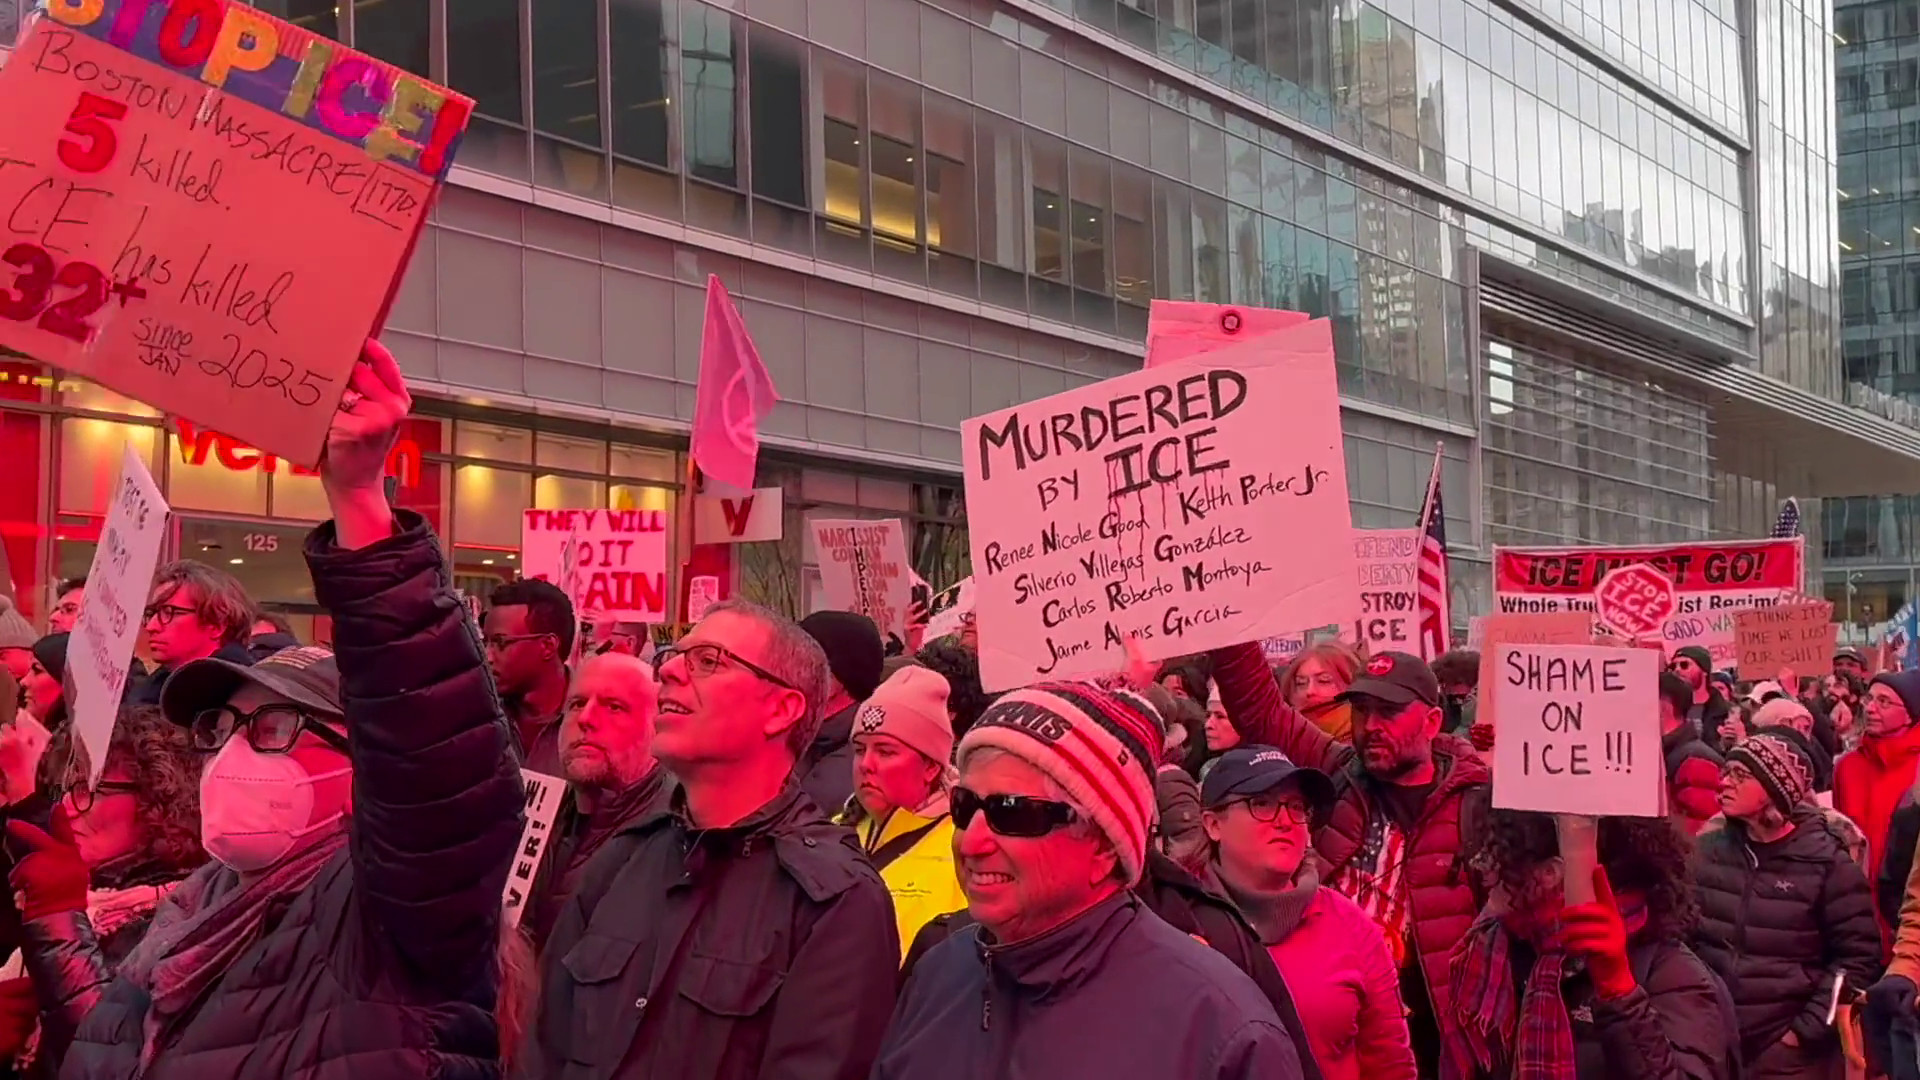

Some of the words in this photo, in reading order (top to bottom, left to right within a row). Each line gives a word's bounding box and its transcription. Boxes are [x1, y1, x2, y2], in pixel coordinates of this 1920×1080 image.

[32, 31, 187, 118] BOSTON
[188, 95, 367, 196] MASSACRE
[282, 39, 468, 174] ICE!
[57, 91, 128, 172] 5
[110, 205, 172, 284] has
[180, 244, 294, 334] killed
[133, 317, 193, 358] since
[199, 334, 334, 406] 2025
[138, 345, 181, 377] JAN
[979, 369, 1247, 481] MURDERED
[1038, 469, 1078, 511] BY
[1104, 426, 1230, 499] ICE
[1178, 484, 1233, 525] Keith
[1239, 473, 1296, 506] Porter
[1295, 464, 1329, 496] Jr.
[243, 533, 278, 551] 125
[525, 510, 597, 531] THEY
[605, 509, 665, 533] WILL
[984, 540, 1034, 576] Renee
[1041, 520, 1094, 555] Nicole
[1098, 506, 1151, 540] Good
[599, 540, 634, 567] IT
[1528, 557, 1583, 587] ICE
[1592, 555, 1692, 586] MST
[1704, 551, 1767, 584] GO!
[1014, 570, 1077, 605] Silverio
[1079, 549, 1145, 584] Villegas
[1042, 596, 1096, 628] Carlos
[1104, 577, 1173, 613] Roberto
[1181, 557, 1273, 592] Montoya
[1621, 571, 1669, 604] STOP
[1500, 595, 1558, 613] Whole
[1566, 597, 1600, 613] Tru
[1737, 613, 1750, 627] I
[1757, 610, 1793, 624] THINK
[1036, 637, 1092, 674] Jaime
[1103, 621, 1154, 651] Alnis
[1161, 603, 1242, 637] Garcia
[1355, 619, 1407, 641] ICE
[1662, 618, 1704, 641] GOOD
[1741, 631, 1769, 645] TIME
[1779, 629, 1793, 643] WE
[1801, 625, 1828, 640] LOST
[1507, 650, 1627, 692] SHAME
[1743, 650, 1774, 665] OUR
[1780, 646, 1824, 663] SHIT
[1542, 701, 1583, 732] ON
[1523, 741, 1591, 776] ICE
[1604, 732, 1633, 773] !!!
